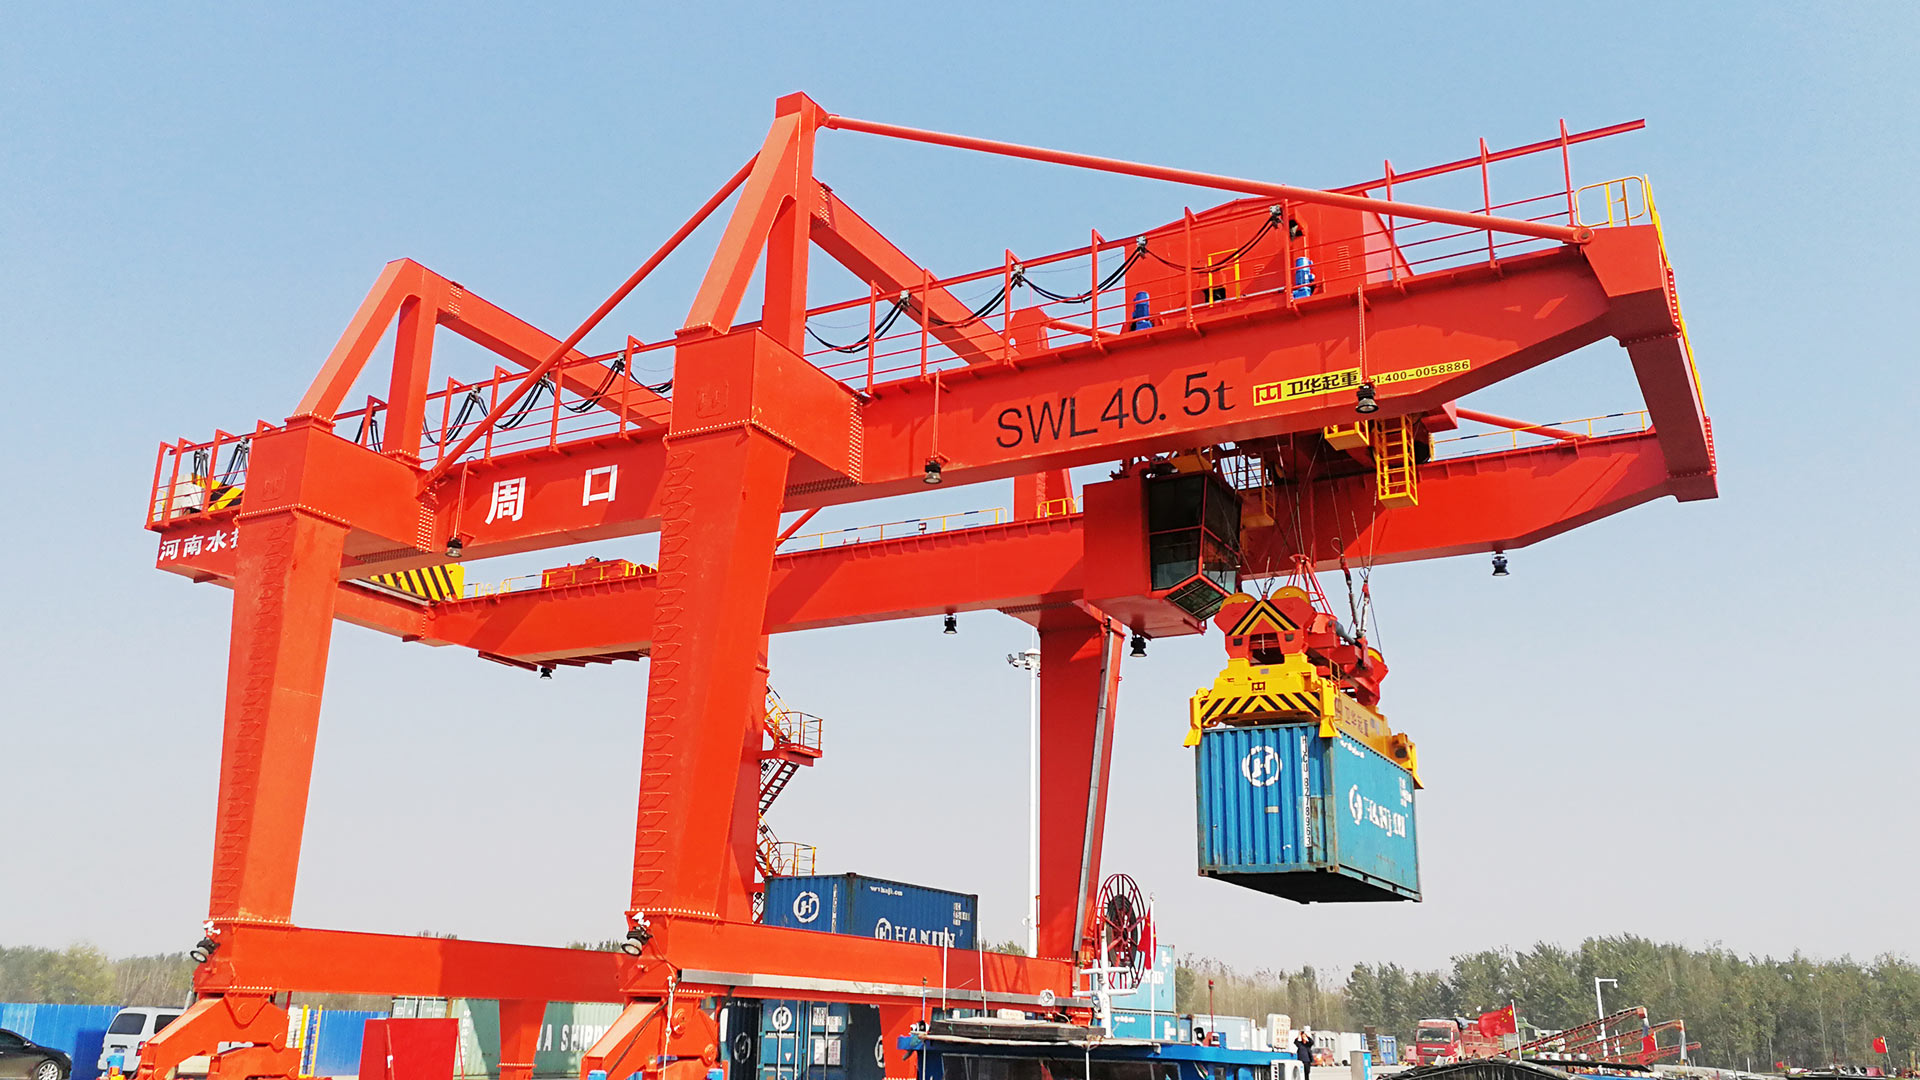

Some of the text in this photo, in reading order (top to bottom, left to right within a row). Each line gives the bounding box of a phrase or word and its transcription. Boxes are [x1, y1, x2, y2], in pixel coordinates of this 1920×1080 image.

[1286, 369, 1361, 397] 卫华起重
[1371, 360, 1470, 384] l:400-0058886
[996, 396, 1098, 448] SWL
[484, 464, 618, 525] 周口
